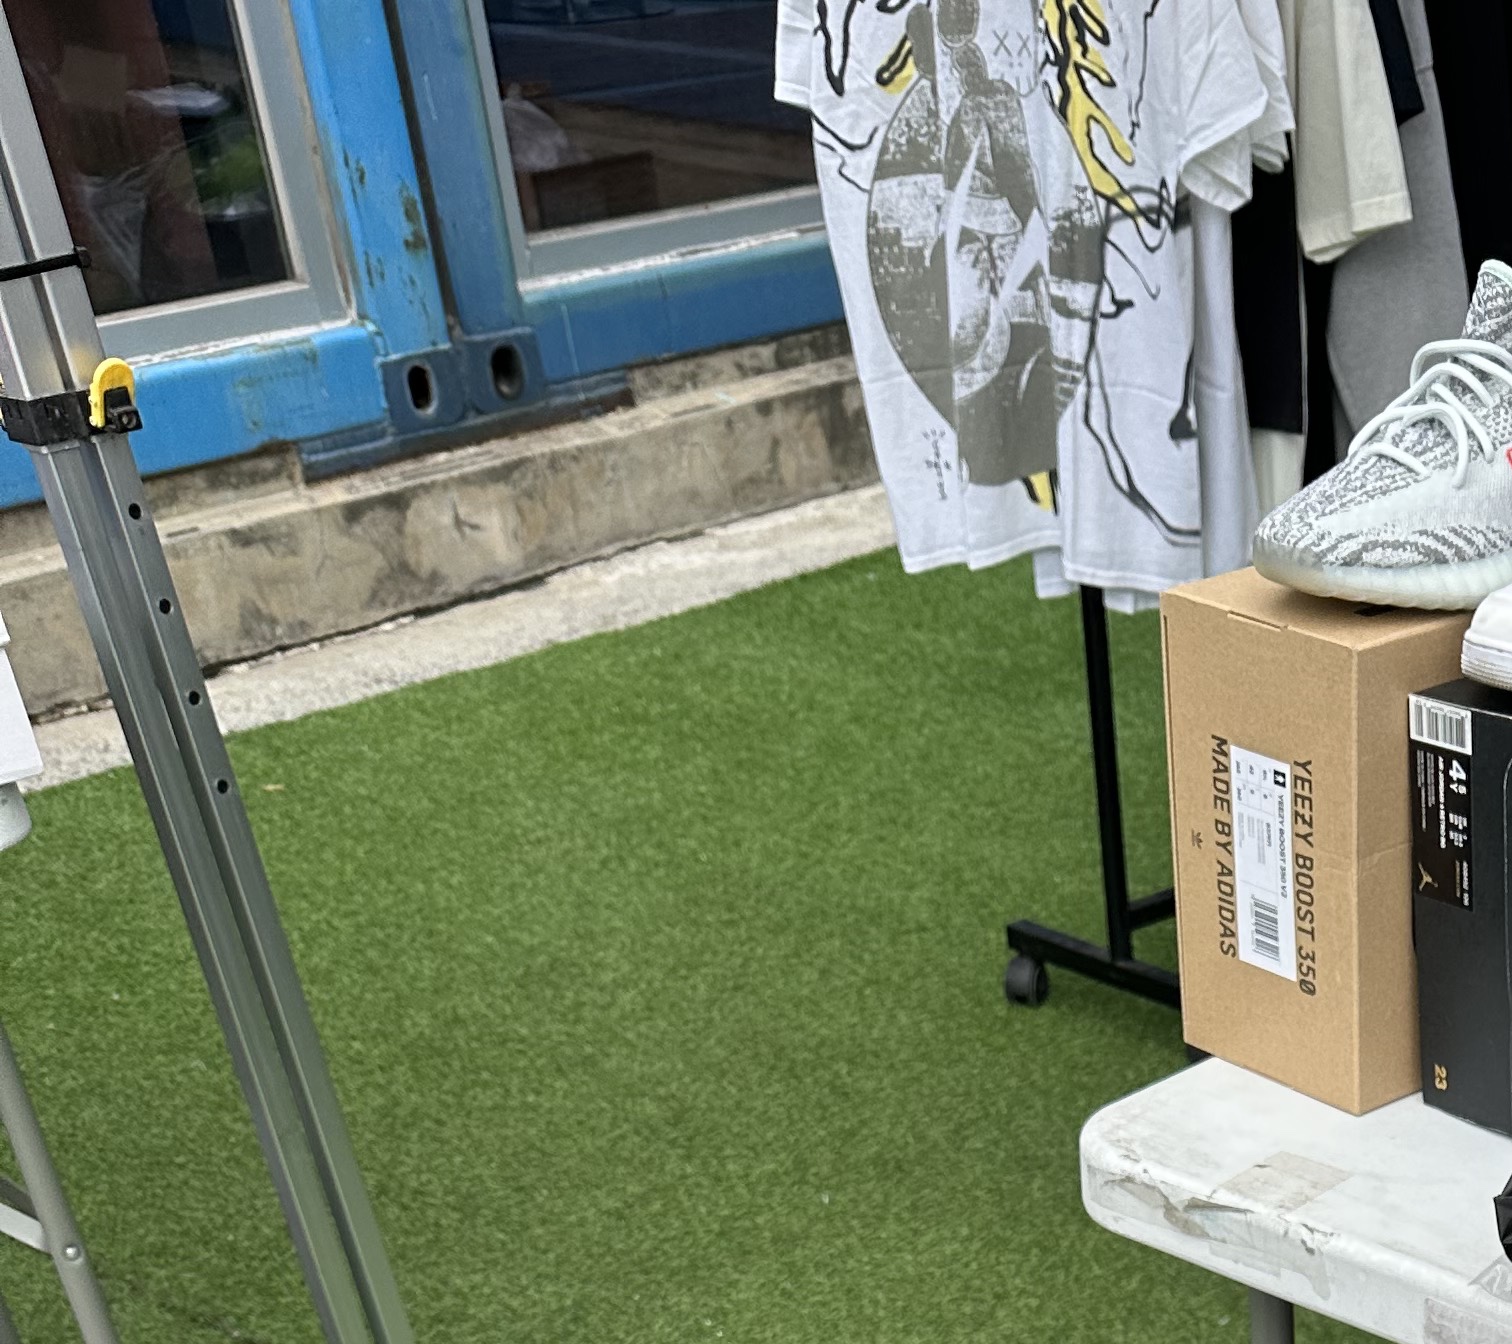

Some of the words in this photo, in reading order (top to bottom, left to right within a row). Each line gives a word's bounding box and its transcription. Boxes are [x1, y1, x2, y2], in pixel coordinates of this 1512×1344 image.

[1210, 734, 1232, 814] MADE
[1448, 759, 1467, 781] 4
[1293, 759, 1313, 849] YEEZY
[1214, 818, 1233, 857] BY
[1216, 859, 1237, 959] ADIDAS
[1295, 852, 1316, 943] BOOST
[1298, 945, 1318, 997] 350
[1433, 1063, 1448, 1091] 23
